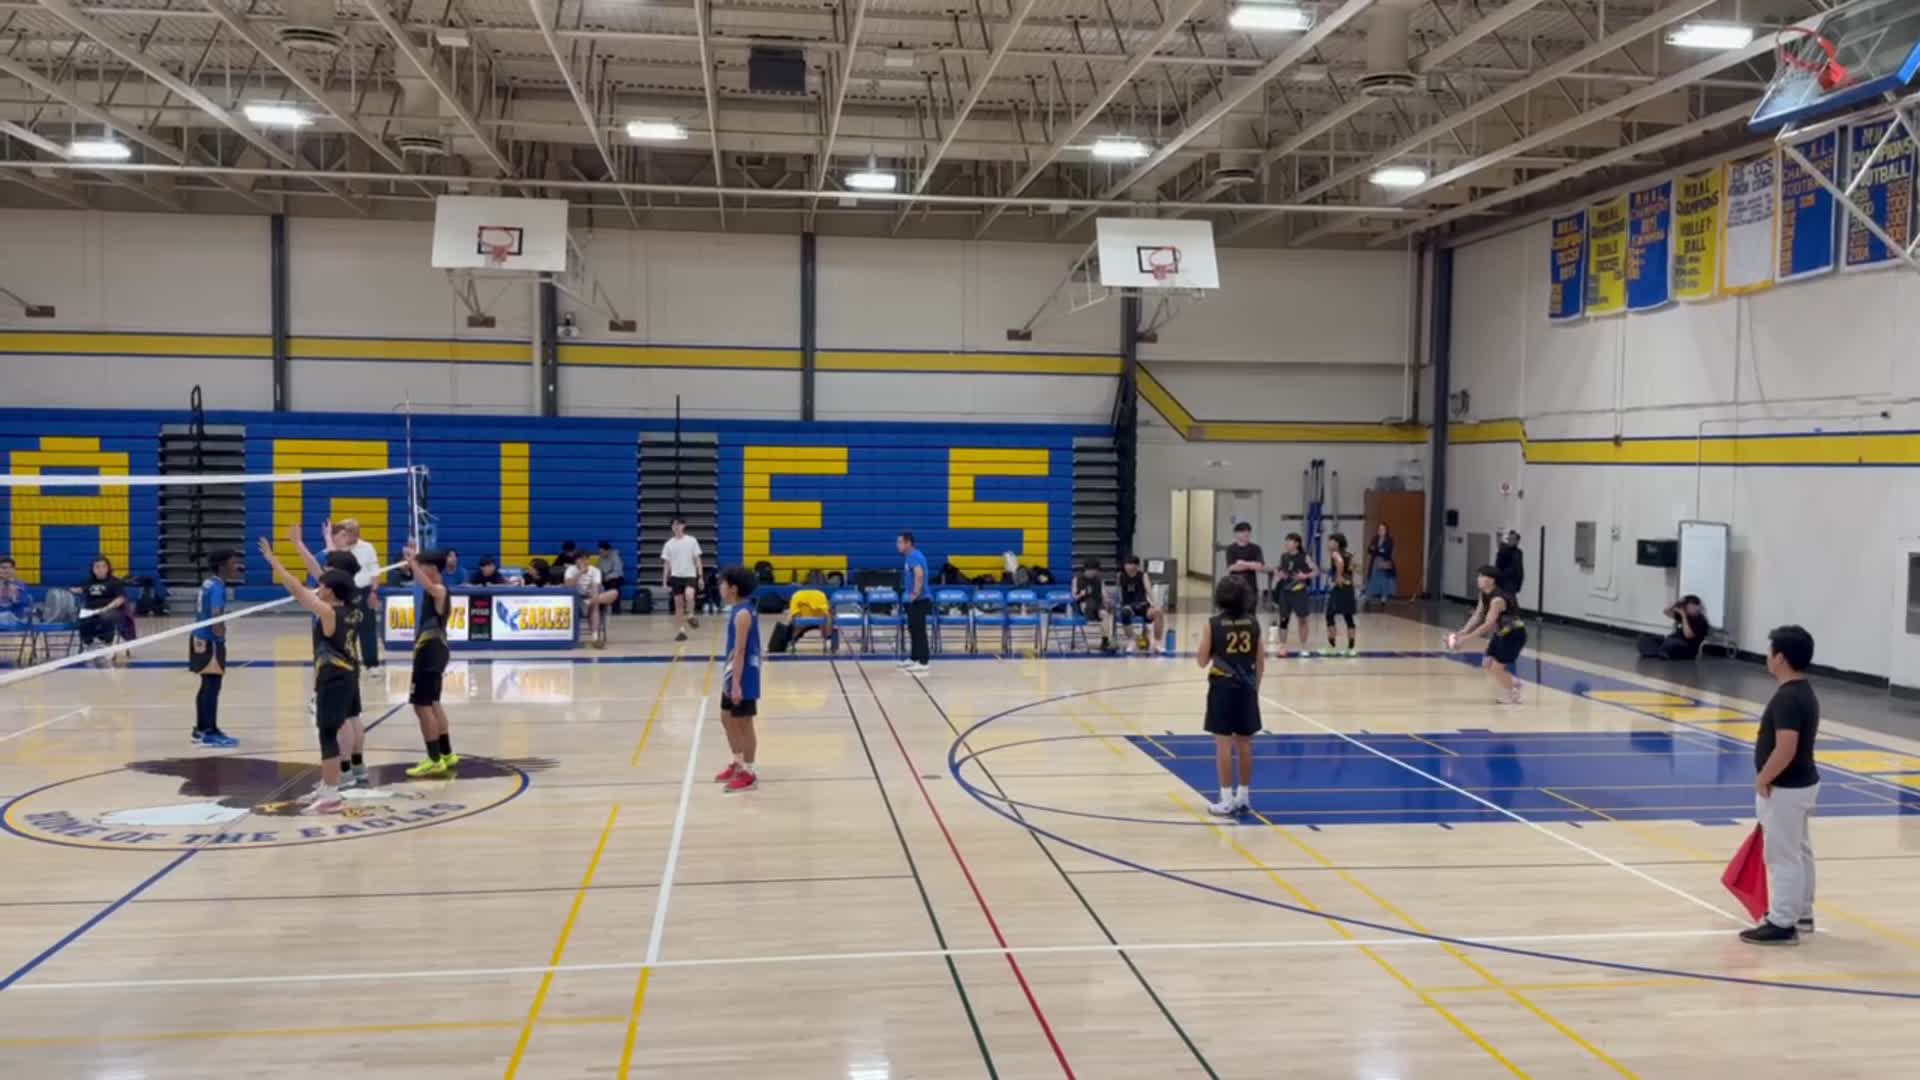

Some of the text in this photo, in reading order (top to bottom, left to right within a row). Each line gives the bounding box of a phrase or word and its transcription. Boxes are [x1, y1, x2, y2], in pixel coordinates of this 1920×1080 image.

[519, 607, 571, 630] EAGLES
[1225, 631, 1251, 654] 23
[24, 803, 467, 844] HOME OF THE EAGLES
